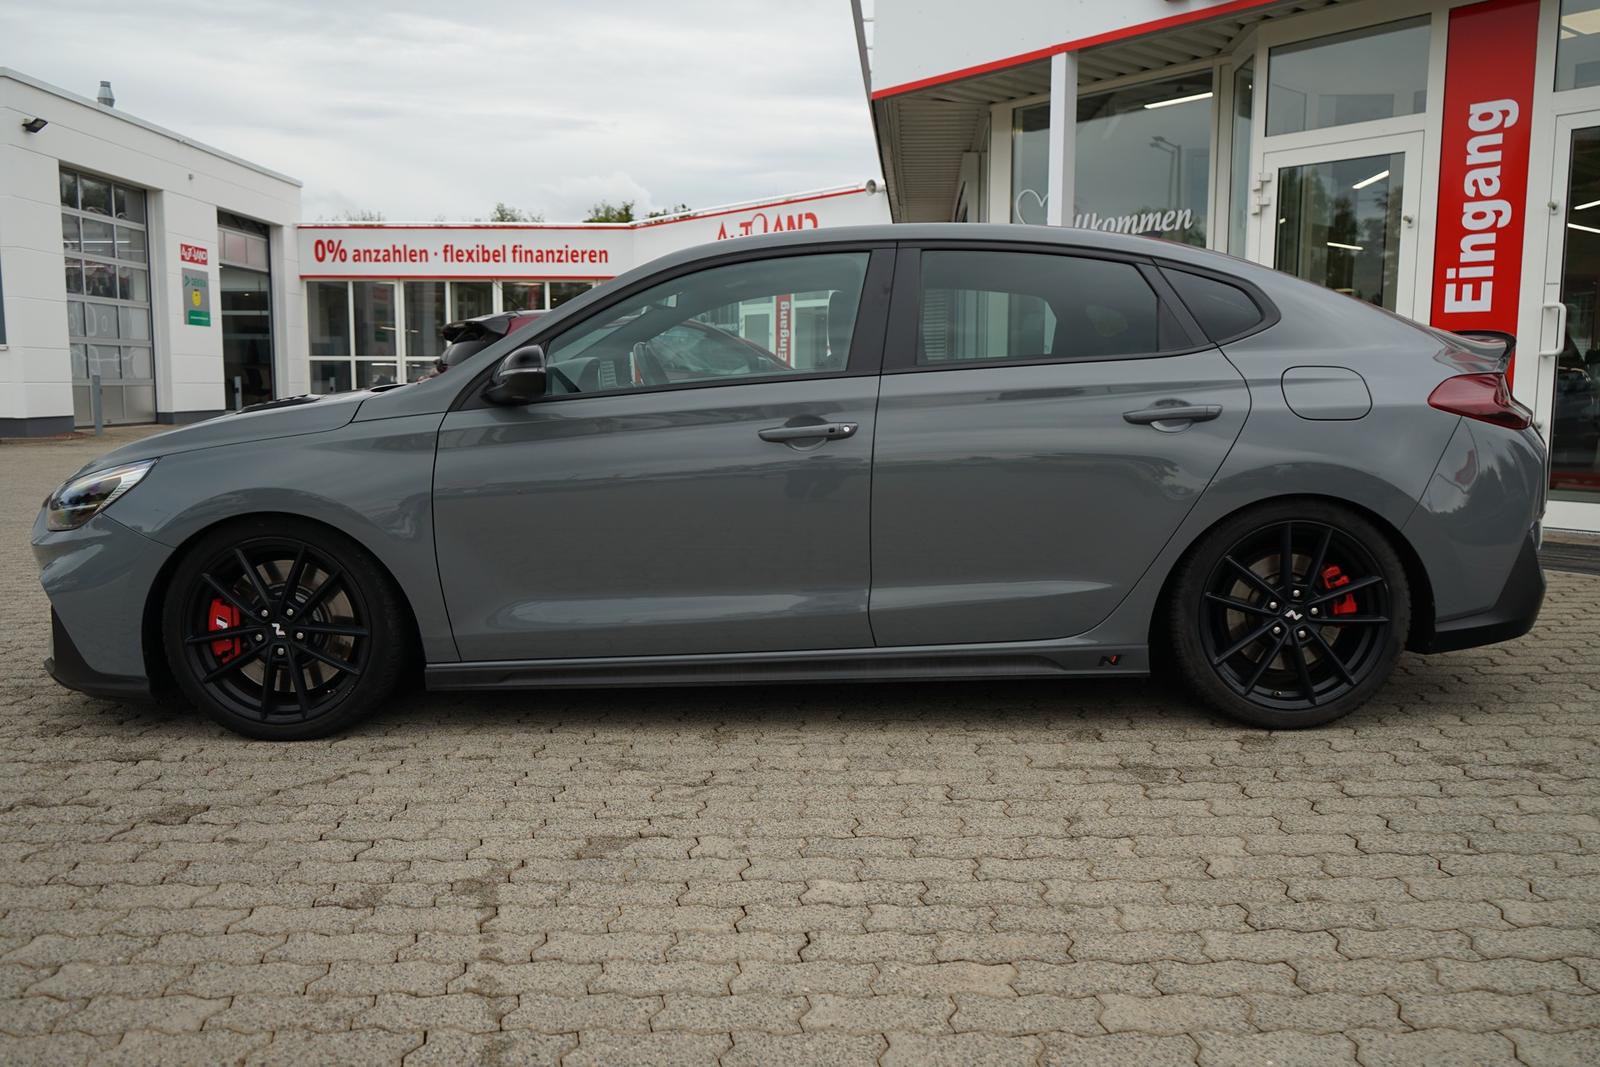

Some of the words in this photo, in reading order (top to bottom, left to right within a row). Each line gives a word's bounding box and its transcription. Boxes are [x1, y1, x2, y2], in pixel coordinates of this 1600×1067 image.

[313, 238, 348, 264] 0%
[352, 244, 429, 264] anzahlen
[442, 244, 507, 264] flexibel
[511, 244, 609, 264] finanzieren
[1443, 98, 1519, 314] Eingang
